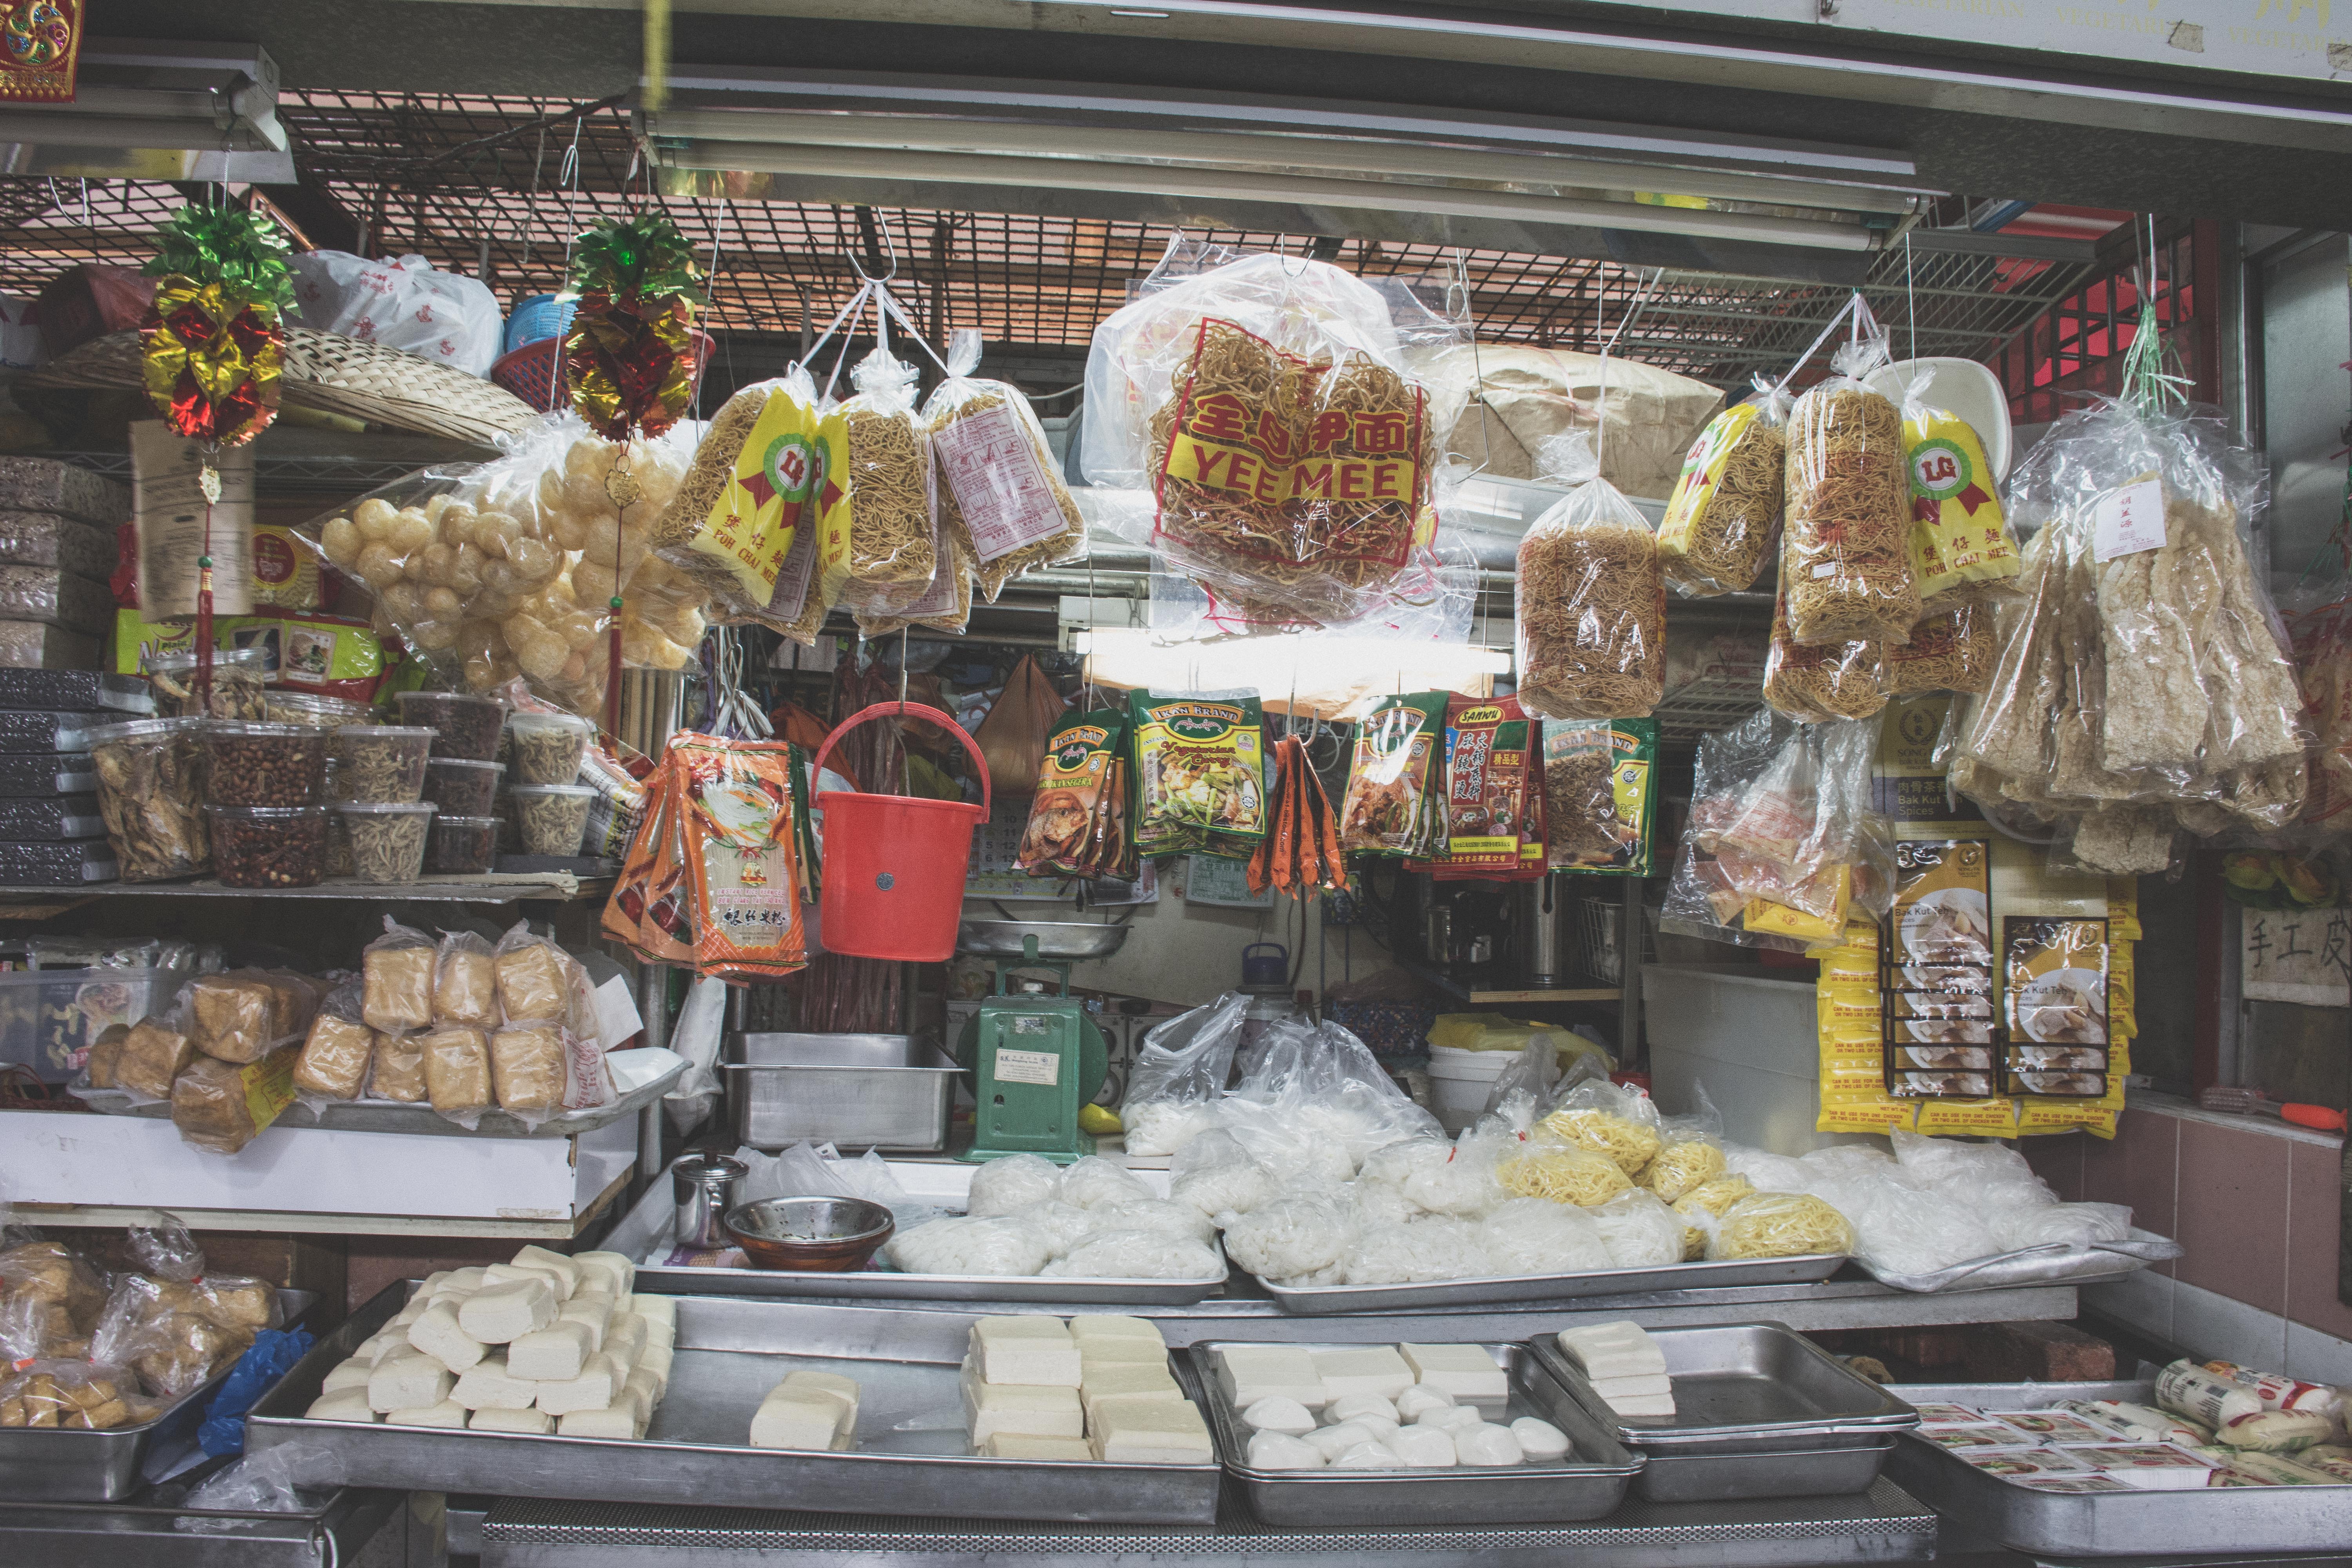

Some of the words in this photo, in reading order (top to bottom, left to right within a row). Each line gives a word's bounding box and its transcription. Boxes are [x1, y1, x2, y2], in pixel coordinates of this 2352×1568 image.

[1193, 444, 1279, 504] YEE
[1293, 463, 1399, 499] MEE
[1921, 456, 1956, 483] LG
[713, 529, 737, 550] POH
[738, 548, 761, 570] CHAI
[1925, 561, 1947, 577] POH
[1953, 552, 1980, 569] CHAI
[1987, 546, 2009, 561] MEE
[1155, 707, 1189, 719] IKAN
[1194, 705, 1238, 721] BRAND
[1461, 710, 1499, 722] SANWU
[1590, 732, 1633, 750] BRAND
[1161, 741, 1236, 757] Vegetarian
[1191, 753, 1231, 768] Curry
[1493, 753, 1520, 766] 精品型
[1898, 795, 1919, 804] Bak
[1922, 795, 1941, 804] Kut
[1898, 806, 1935, 818] Spices
[985, 841, 993, 849] 5
[1004, 841, 1016, 850] 12
[1895, 908, 1913, 916] Bak
[1915, 907, 1931, 916] Kut
[1932, 907, 1949, 915] Teh
[2032, 985, 2048, 994] Kut
